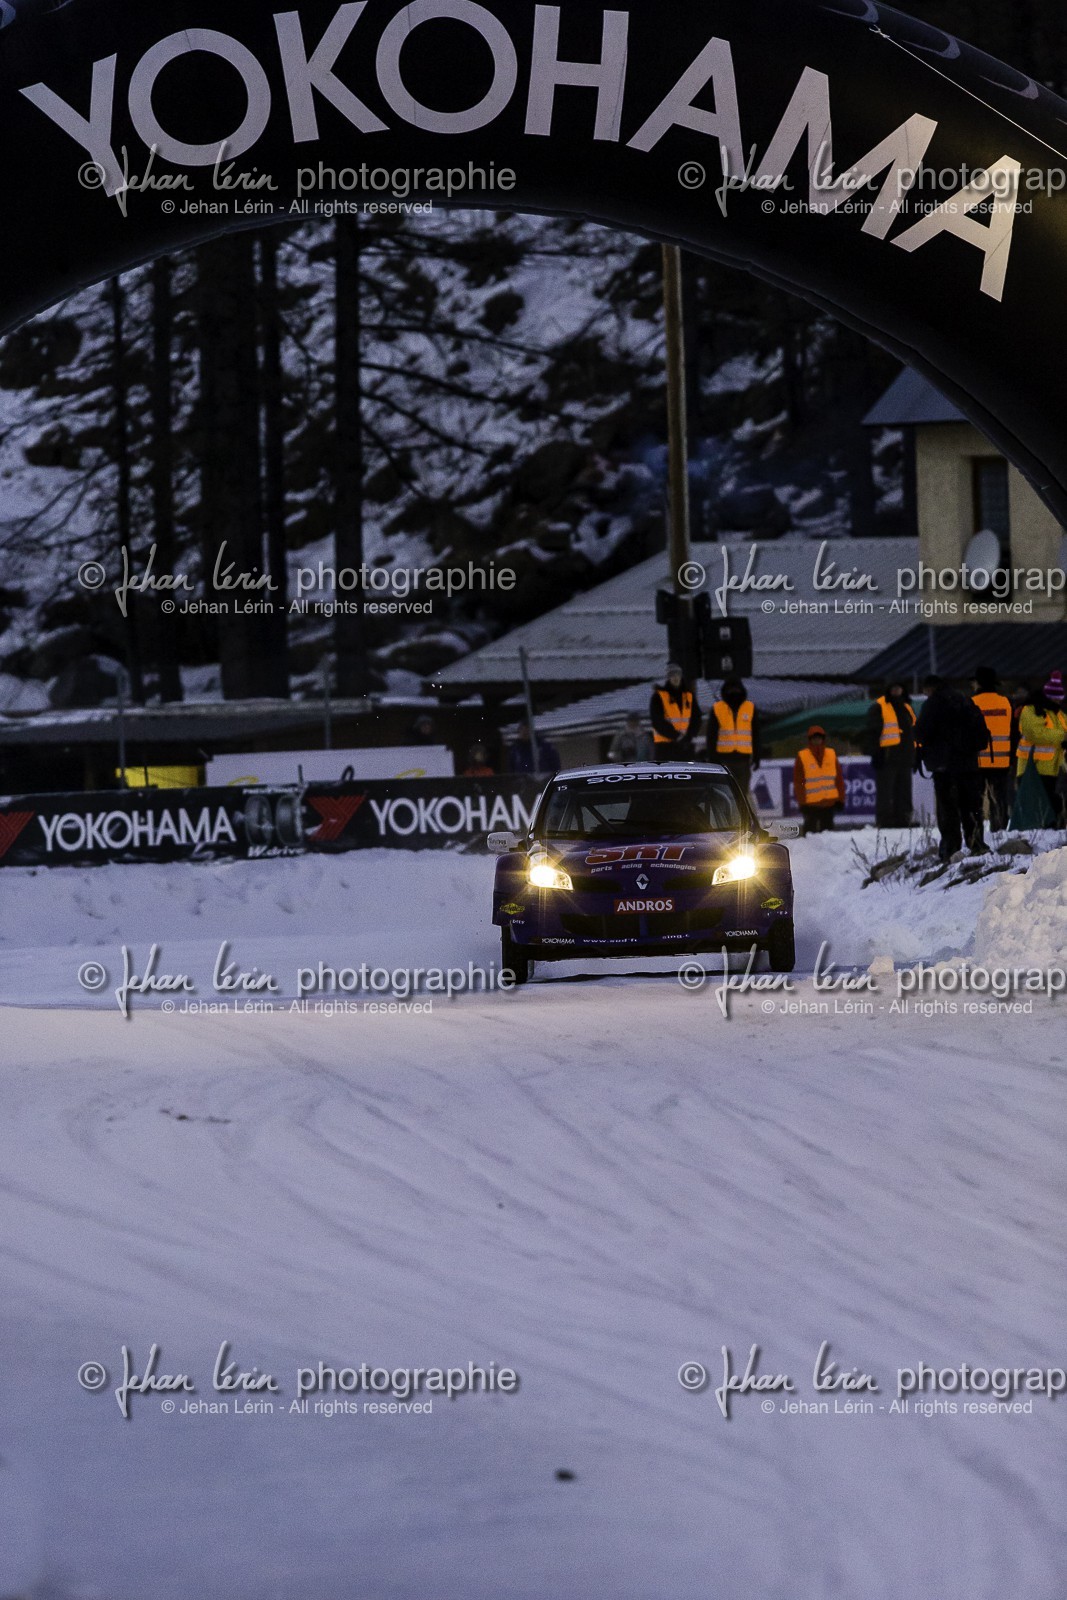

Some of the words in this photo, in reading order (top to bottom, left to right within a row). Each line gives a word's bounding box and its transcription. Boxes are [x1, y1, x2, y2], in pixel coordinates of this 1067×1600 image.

[19, 0, 1021, 302] YOKOHAMA
[587, 773, 692, 785] SODEMO
[38, 806, 237, 851] YOKOHAMA
[585, 844, 696, 865] SRT
[617, 899, 673, 912] ANDROS
